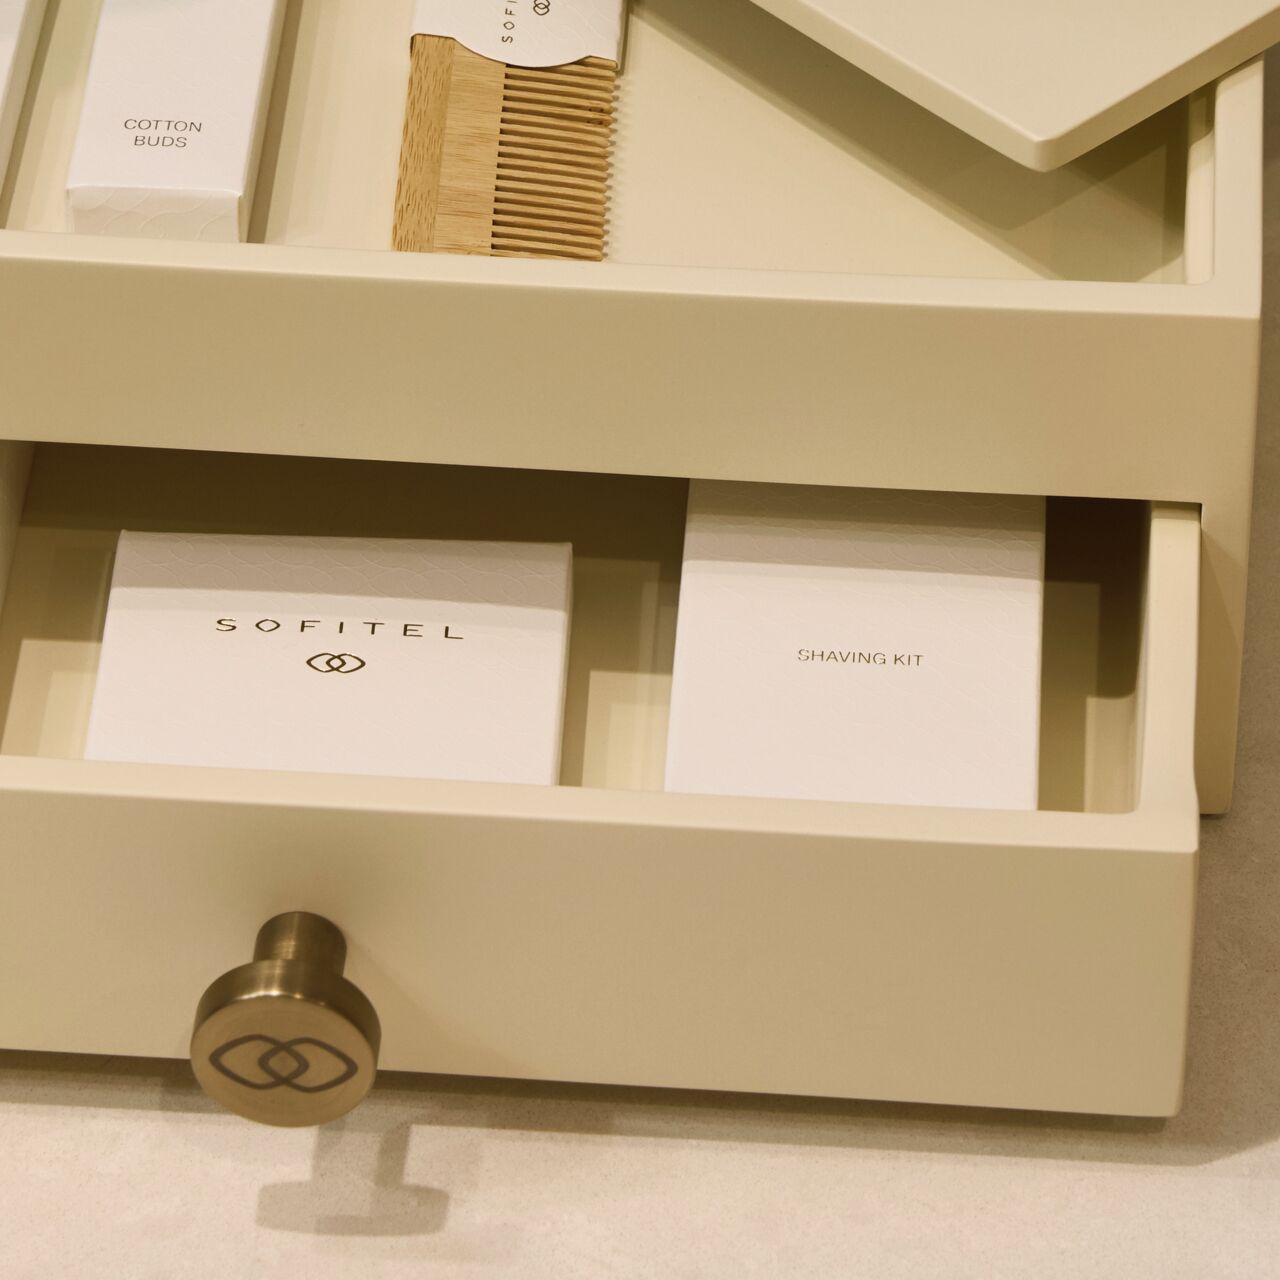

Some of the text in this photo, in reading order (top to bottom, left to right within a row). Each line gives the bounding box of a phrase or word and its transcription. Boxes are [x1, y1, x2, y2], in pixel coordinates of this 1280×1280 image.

[123, 118, 203, 133] COTTON
[133, 134, 188, 149] BUDS
[214, 617, 465, 640] SOFITEL
[797, 648, 925, 667] SHAVING KIT
